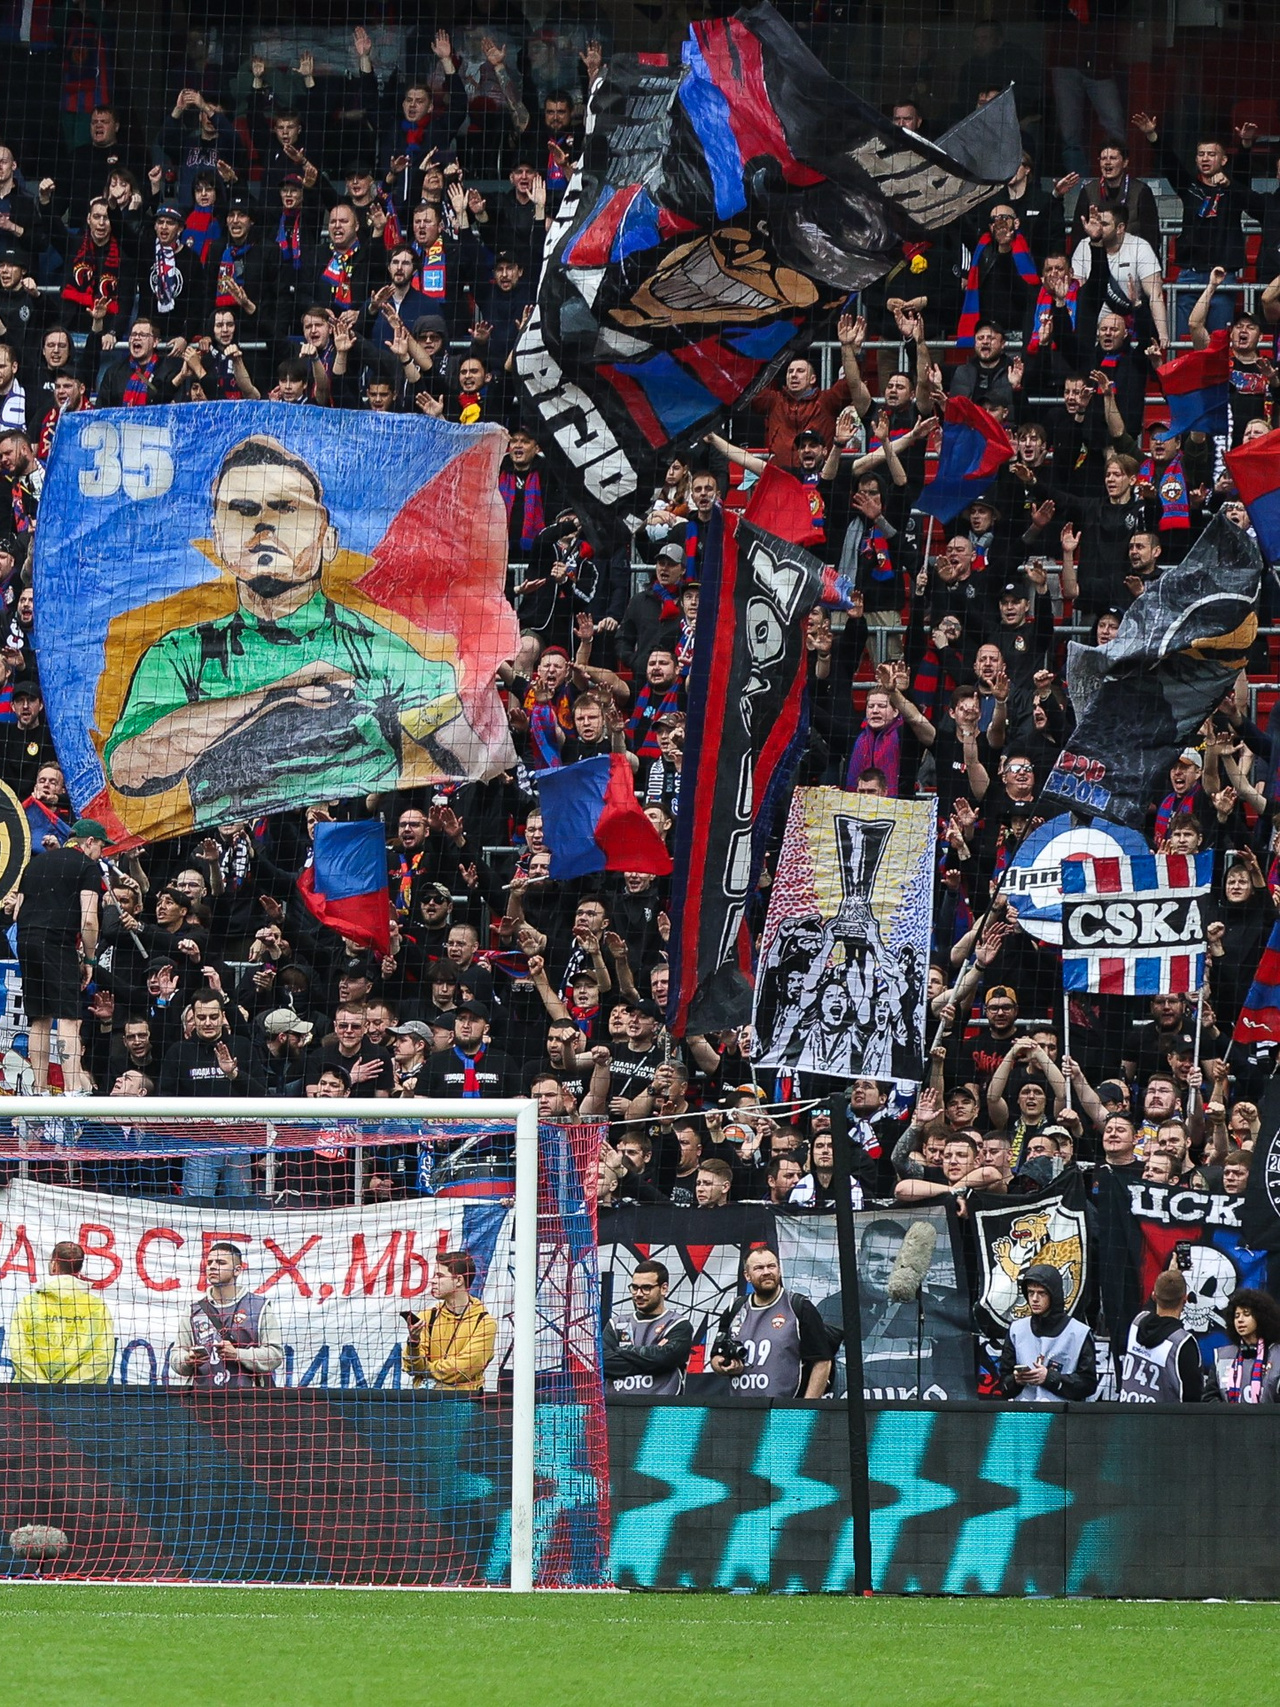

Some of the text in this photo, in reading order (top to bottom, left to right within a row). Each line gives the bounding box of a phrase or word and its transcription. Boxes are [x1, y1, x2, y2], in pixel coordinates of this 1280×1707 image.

[78, 420, 175, 500] 35
[1068, 900, 1204, 945] CSKA
[1127, 1184, 1246, 1227] ЦСК
[44, 1314, 86, 1325] SAFETY
[731, 1375, 769, 1391] ФОТО
